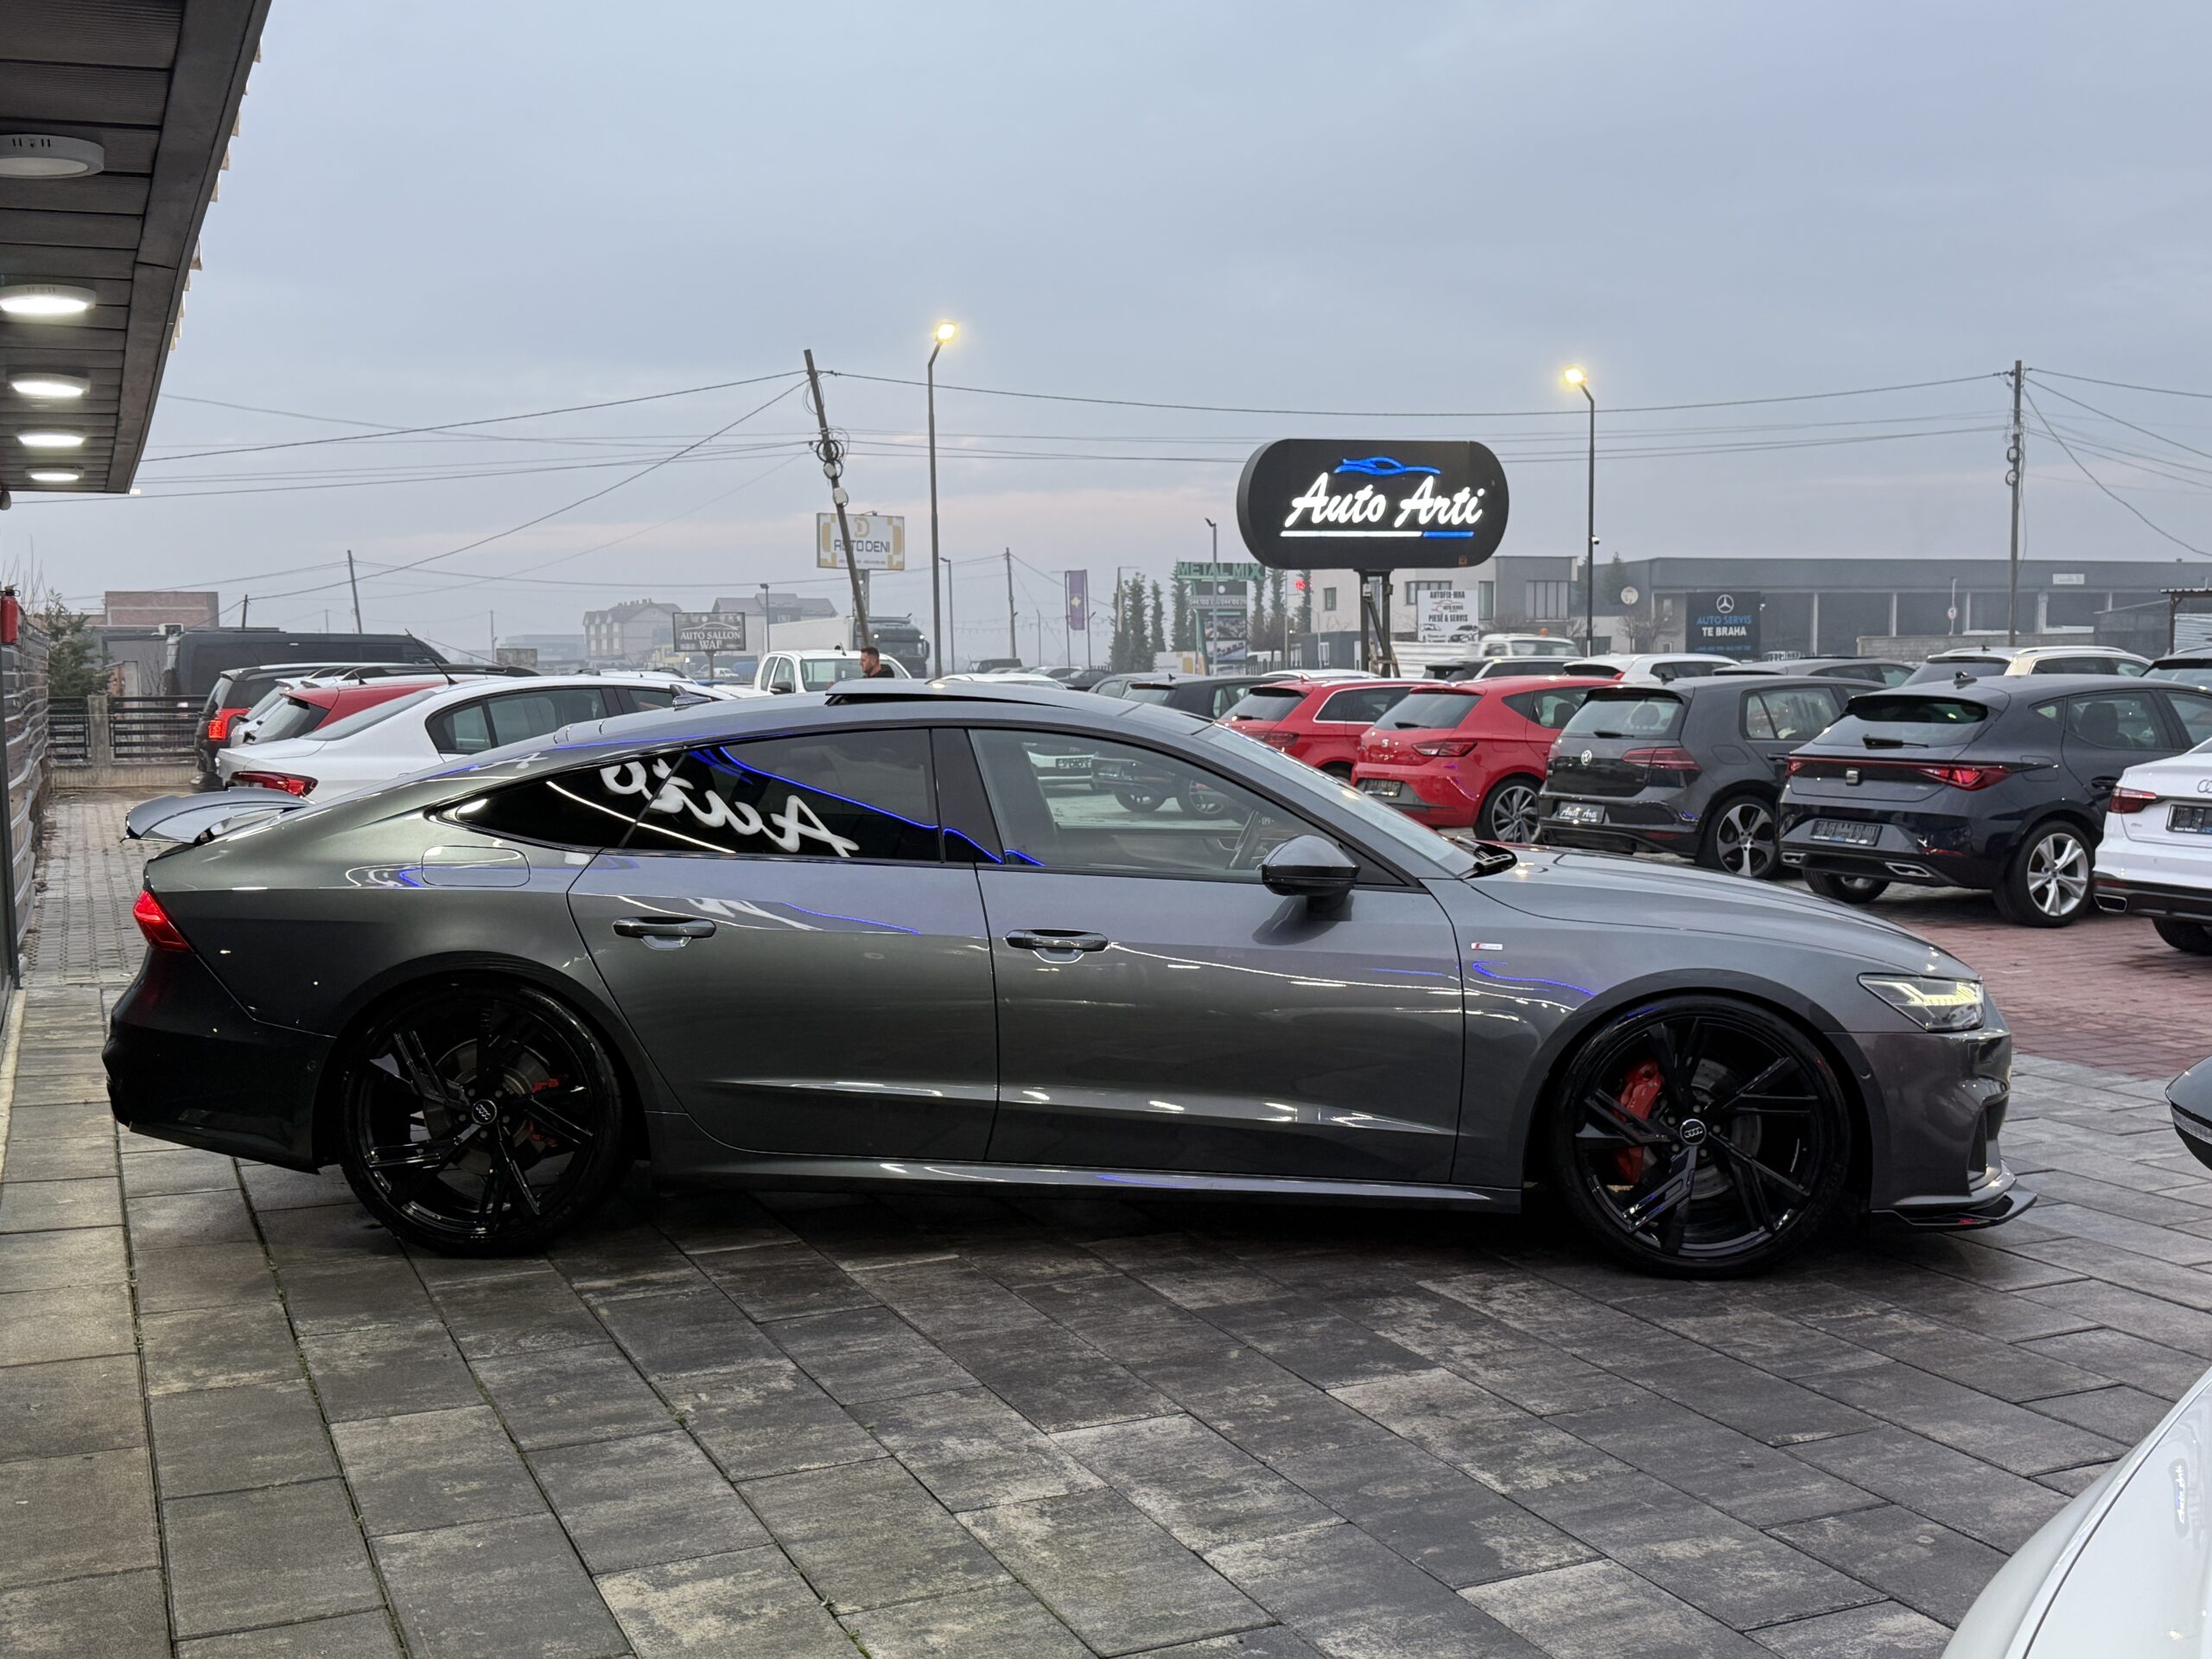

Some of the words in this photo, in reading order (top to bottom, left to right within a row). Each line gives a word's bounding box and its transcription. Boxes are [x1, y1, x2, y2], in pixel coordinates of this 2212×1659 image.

[1284, 471, 1387, 528] Auto
[1393, 474, 1485, 529] Arti
[834, 539, 864, 552] ATO
[865, 541, 891, 553] DENI
[1176, 562, 1230, 577] METAL
[1231, 563, 1264, 581] MIX
[1696, 615, 1722, 626] AUTO
[1723, 614, 1752, 625] SERVIS
[1701, 626, 1713, 637] TE
[1715, 626, 1746, 637] BRAHA
